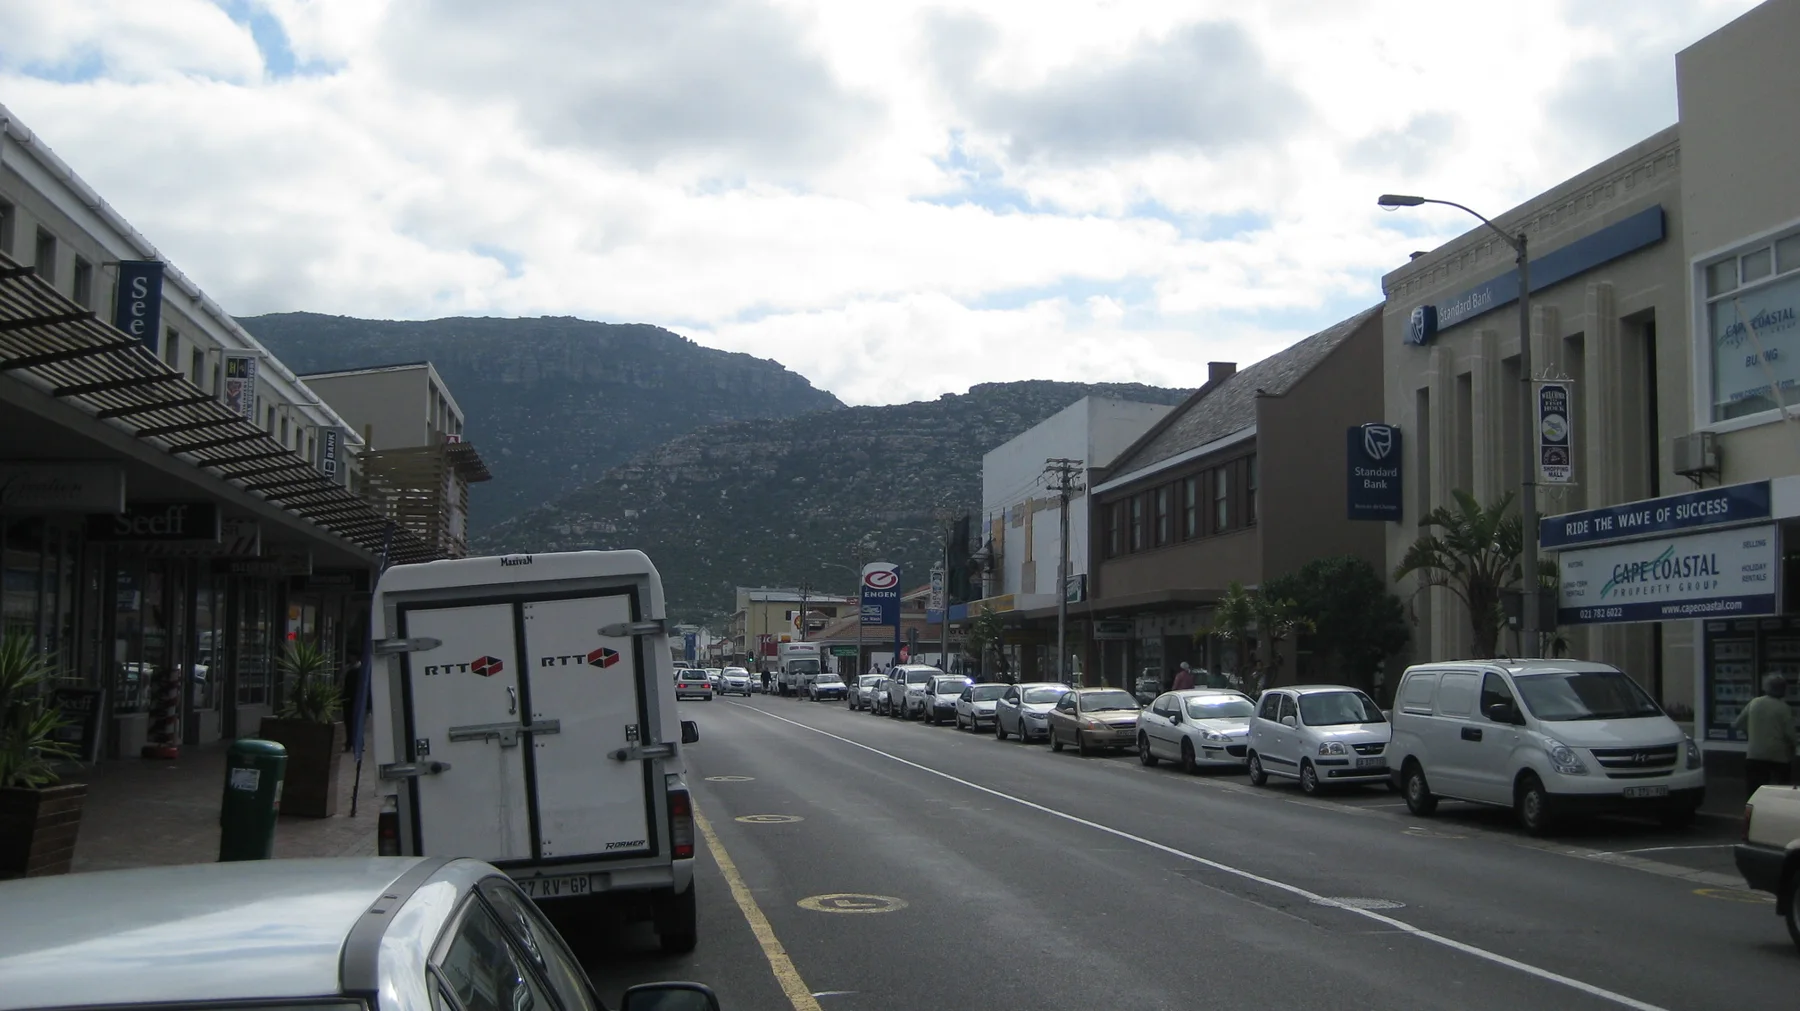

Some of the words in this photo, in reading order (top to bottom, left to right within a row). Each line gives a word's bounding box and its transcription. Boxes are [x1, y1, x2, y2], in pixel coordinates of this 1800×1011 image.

[130, 276, 149, 340] See
[1439, 295, 1472, 323] Standard
[1472, 287, 1493, 308] Bank
[1726, 321, 1747, 337] CAP
[1751, 307, 1796, 330] COASTAL
[1745, 348, 1778, 367] BUNG
[327, 433, 336, 459] BANK
[1354, 466, 1398, 477] Standard
[1364, 479, 1388, 489] Bank
[114, 504, 188, 535] Seeff
[1566, 520, 1589, 536] RIDE
[1594, 517, 1613, 532] THE
[1618, 510, 1650, 528] WAVE
[1656, 508, 1671, 523] OF
[1676, 498, 1728, 519] SUCCESS
[1742, 539, 1767, 549] SELLING
[1613, 560, 1649, 585] CAPE
[1652, 553, 1720, 581] COASTAL
[1742, 563, 1767, 572] HOLIDAY
[1742, 573, 1767, 583] RENTALS
[1613, 584, 1670, 597] PROPERTY
[1679, 579, 1718, 592] GROUP
[1580, 609, 1592, 619] 021
[1593, 608, 1606, 618] 782
[1606, 607, 1623, 617] 6022
[1661, 600, 1743, 614] www.capecoastal.com
[424, 662, 470, 676] RTT
[541, 654, 587, 668] RTT
[542, 878, 561, 895] RV
[570, 877, 587, 893] GP
